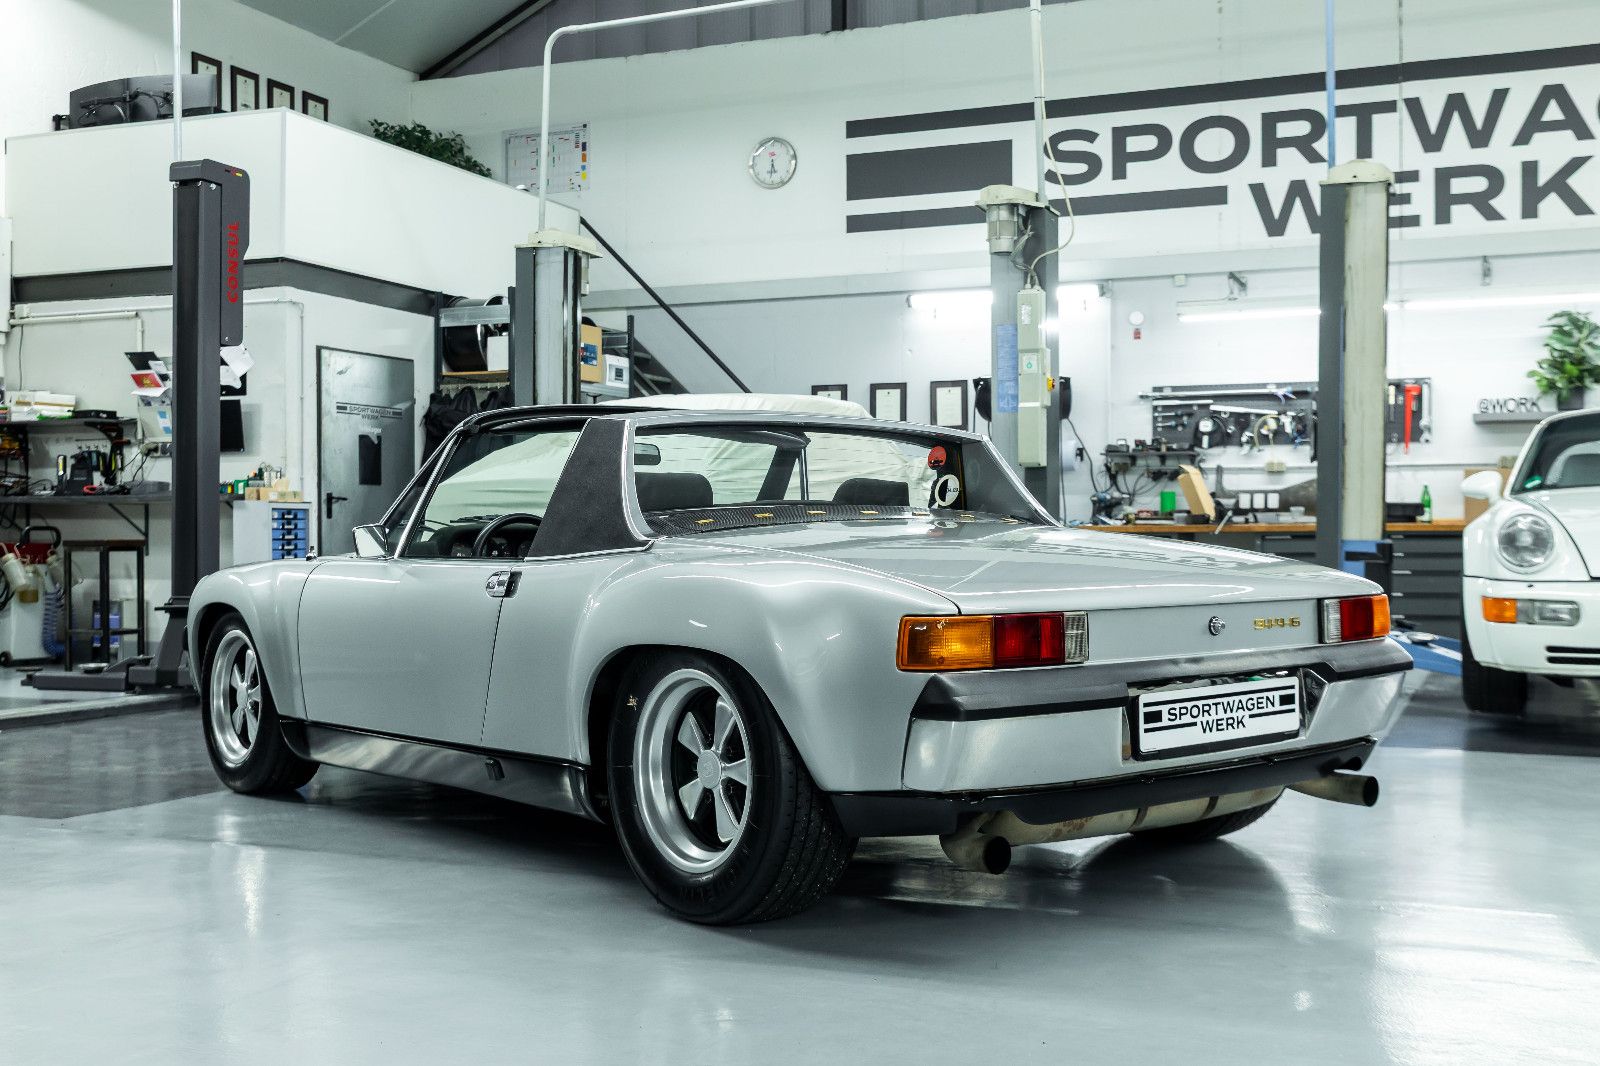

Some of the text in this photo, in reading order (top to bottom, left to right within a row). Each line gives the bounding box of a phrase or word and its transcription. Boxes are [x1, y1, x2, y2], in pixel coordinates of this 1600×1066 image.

[1043, 84, 1600, 186] SPORTWA
[227, 221, 240, 303] CONSUL
[1479, 397, 1542, 413] @WORK
[1167, 695, 1275, 722] SPORTWAGEN
[1200, 715, 1246, 734] WERK
